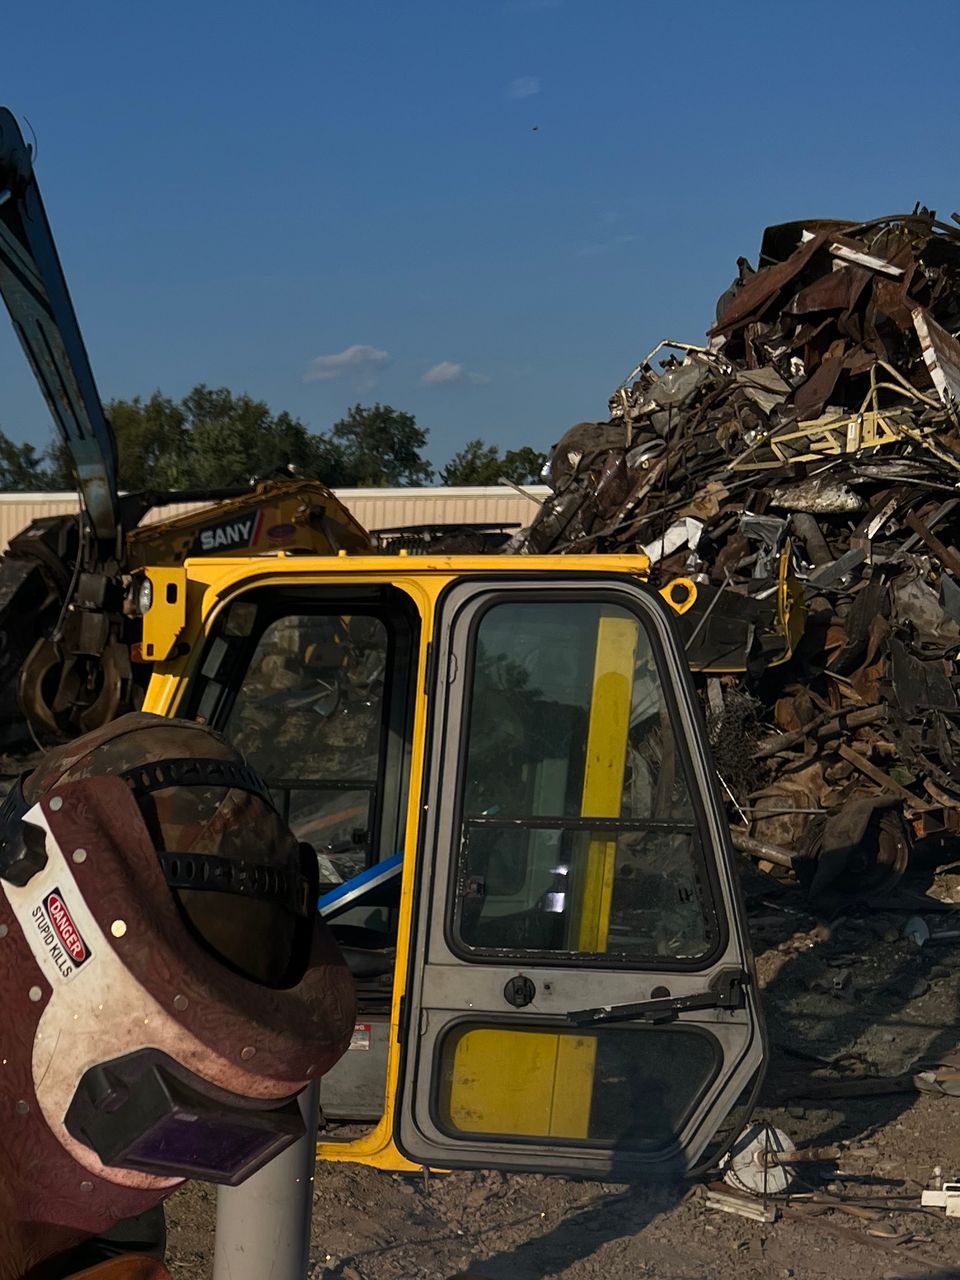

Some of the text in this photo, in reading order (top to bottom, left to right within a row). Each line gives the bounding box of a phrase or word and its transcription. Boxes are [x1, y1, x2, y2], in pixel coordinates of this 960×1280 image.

[200, 521, 252, 550] SANY
[32, 906, 73, 977] STUPID KILLS
[50, 902, 81, 956] DANGER
